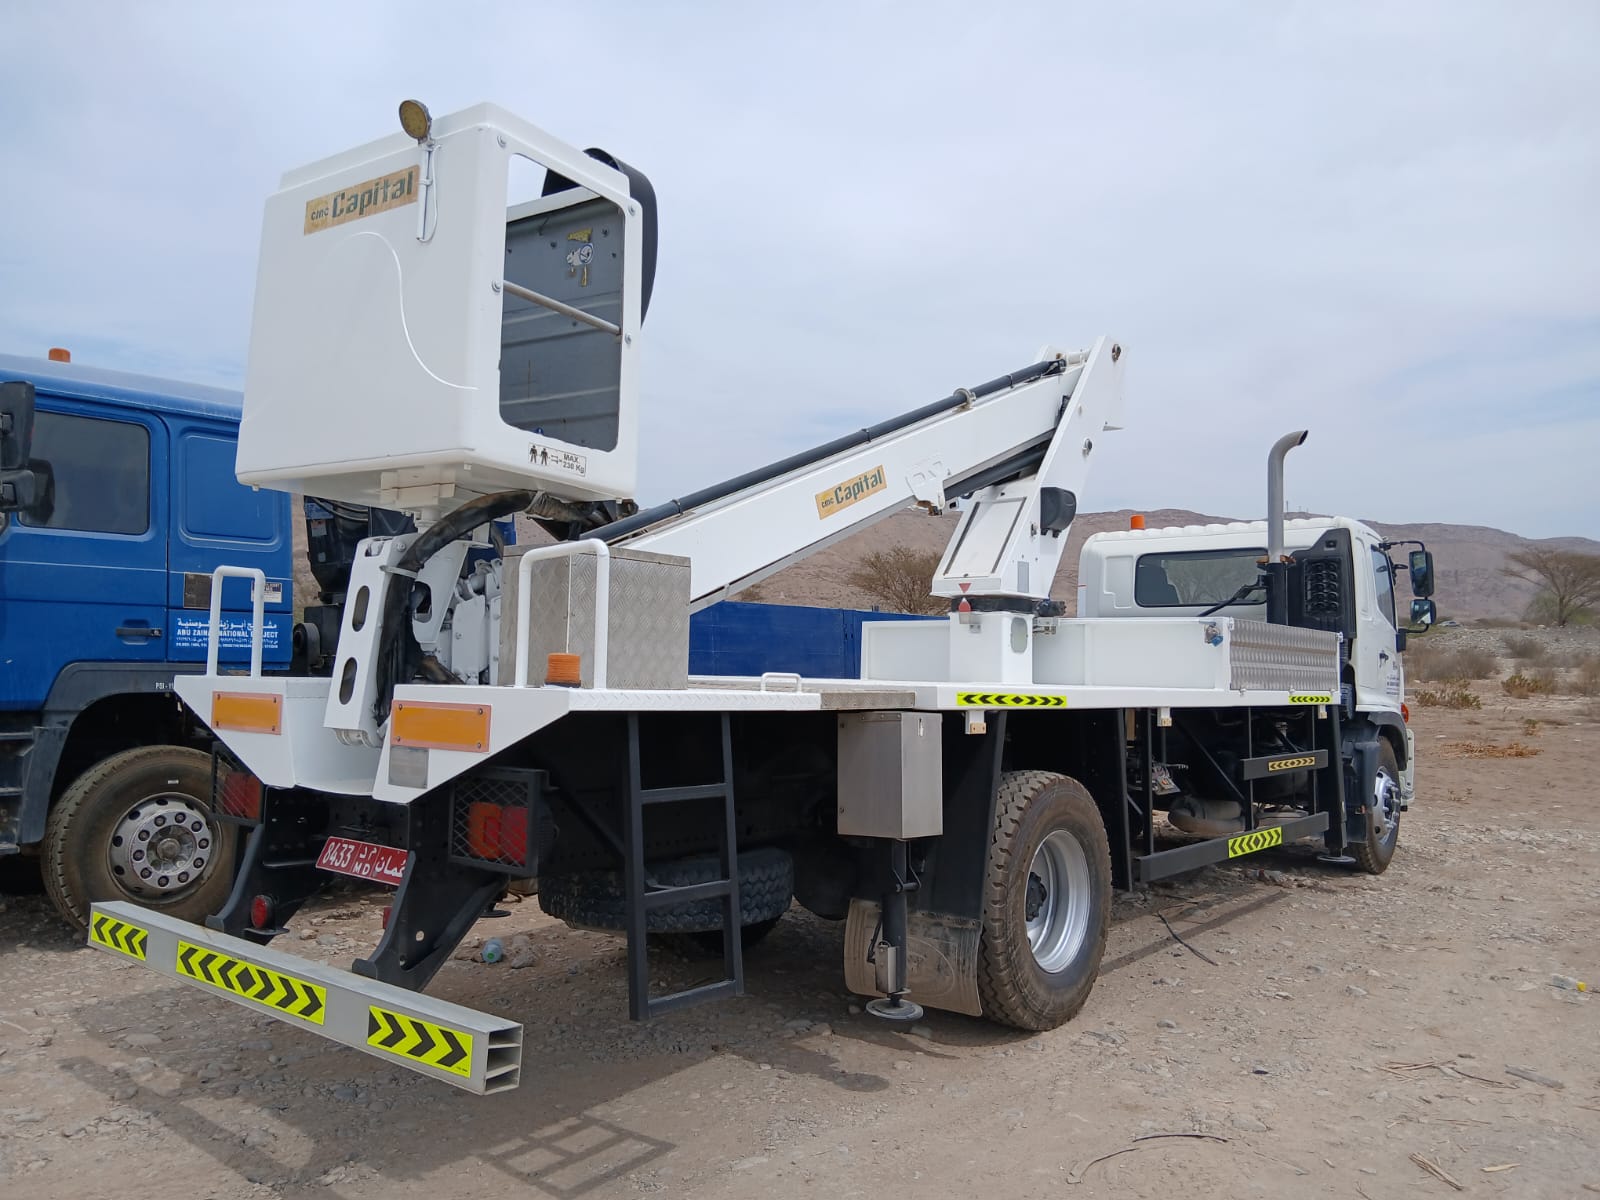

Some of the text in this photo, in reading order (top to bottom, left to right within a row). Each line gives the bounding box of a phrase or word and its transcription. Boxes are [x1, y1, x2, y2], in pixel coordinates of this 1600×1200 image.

[331, 170, 414, 219] Capital
[834, 468, 883, 505] Capital
[322, 842, 355, 869] 8433
